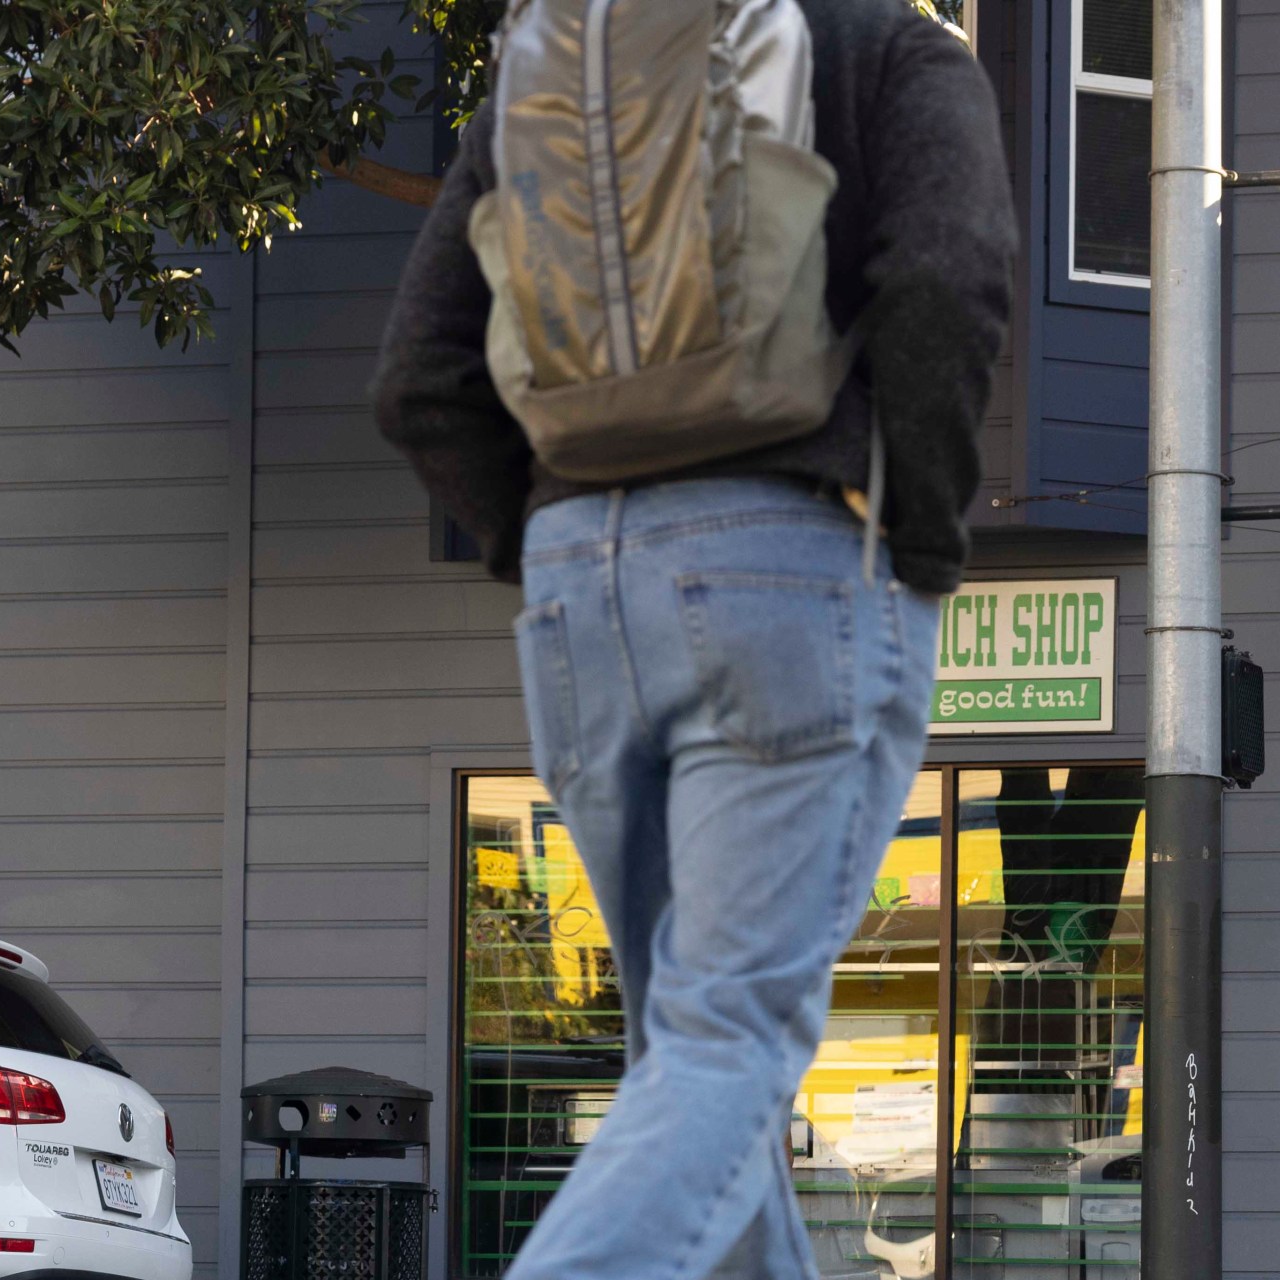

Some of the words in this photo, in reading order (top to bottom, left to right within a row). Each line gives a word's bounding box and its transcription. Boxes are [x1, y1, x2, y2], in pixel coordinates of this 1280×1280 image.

[1012, 592, 1104, 667] SHOP
[938, 683, 1016, 717] good
[1021, 683, 1088, 709] fun!
[25, 1143, 69, 1157] TOUAREG
[103, 1178, 139, 1206] 8TYK321
